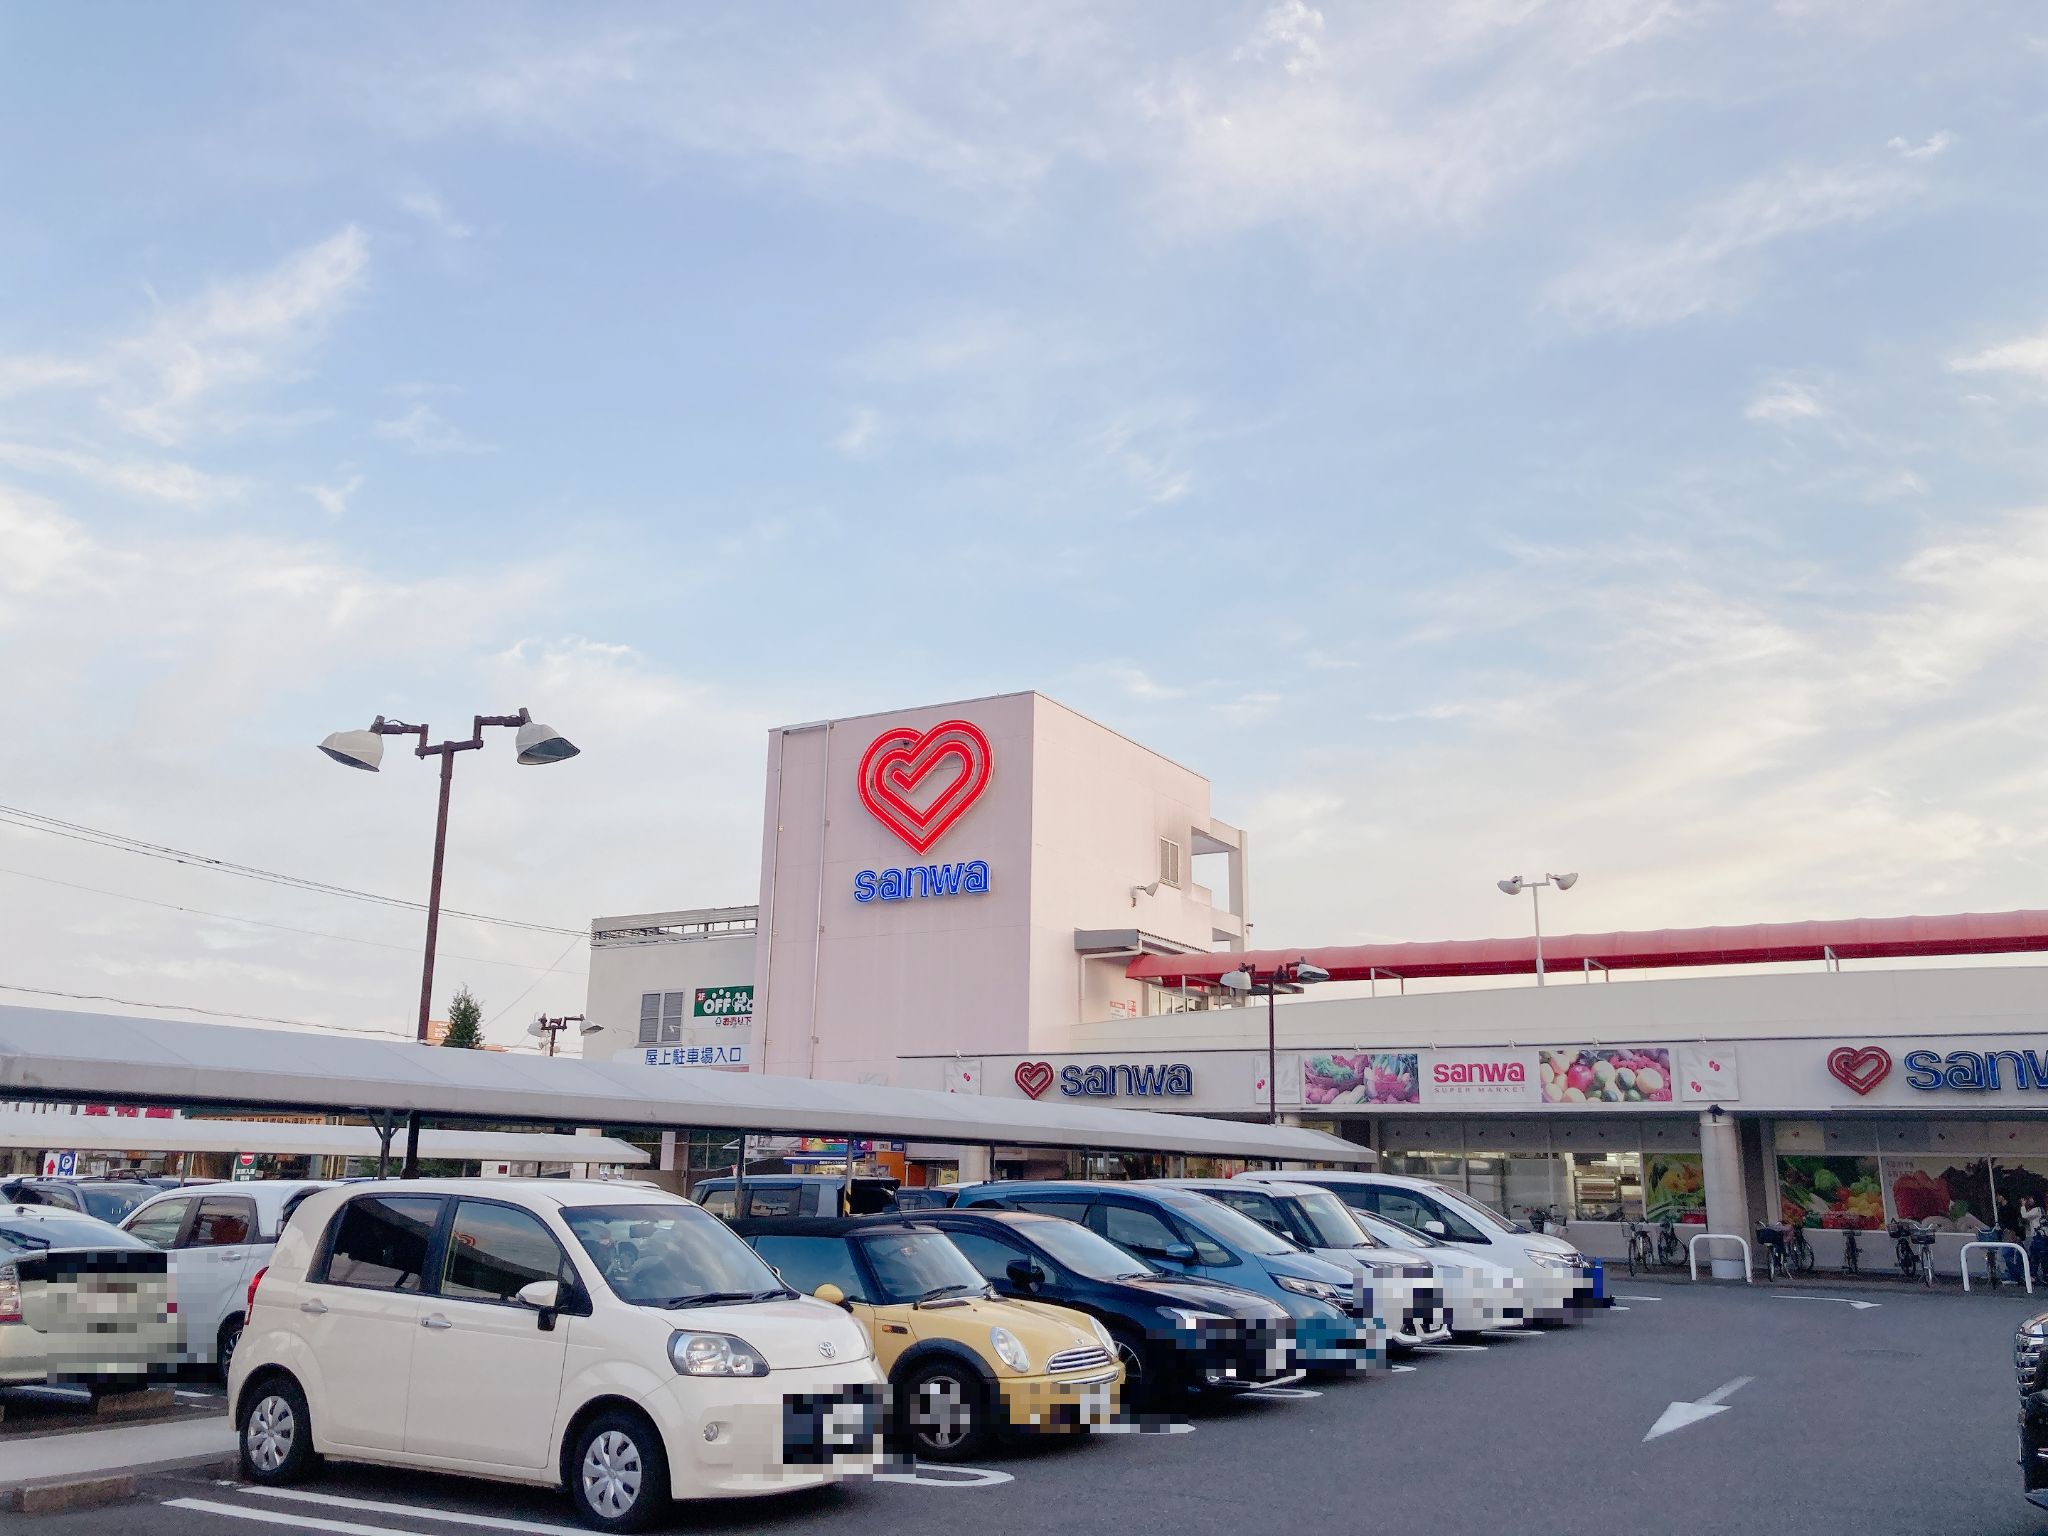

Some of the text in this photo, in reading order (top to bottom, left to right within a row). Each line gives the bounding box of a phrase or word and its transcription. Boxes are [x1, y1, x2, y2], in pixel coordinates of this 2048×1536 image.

[854, 860, 991, 902] sanwa
[697, 992, 706, 1001] 2F
[703, 998, 731, 1014] OFF
[645, 1047, 742, 1065] 屋上駐車場入口
[1060, 1063, 1194, 1097] sanwa
[1433, 1062, 1526, 1083] sanwa
[1434, 1086, 1471, 1094] SUPER
